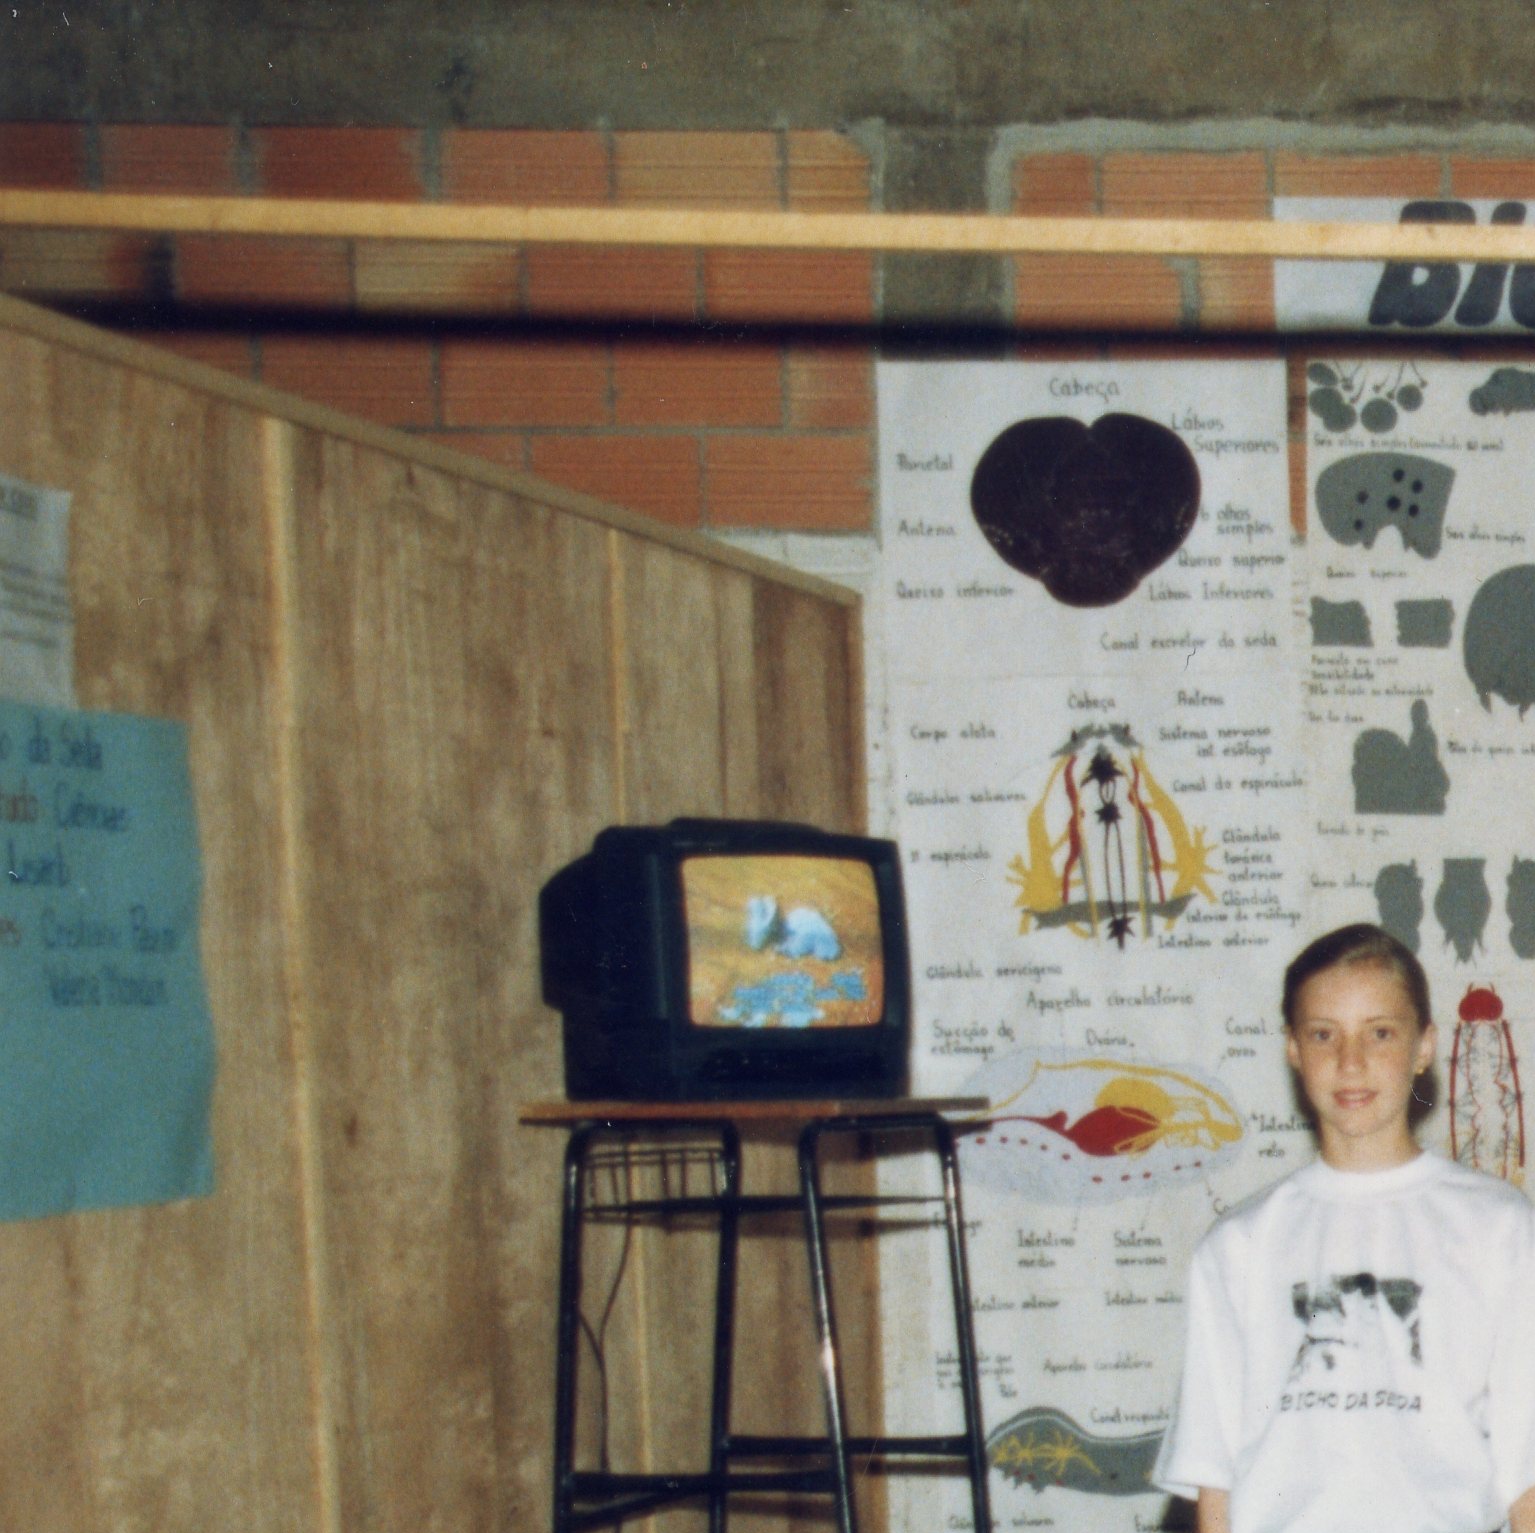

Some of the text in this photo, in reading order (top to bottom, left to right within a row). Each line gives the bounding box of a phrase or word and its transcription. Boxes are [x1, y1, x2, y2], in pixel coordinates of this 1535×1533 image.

[1049, 376, 1120, 402] Cabeça
[1216, 505, 1251, 522] olhos
[1280, 1390, 1422, 1412] BICHO DA SEDA
